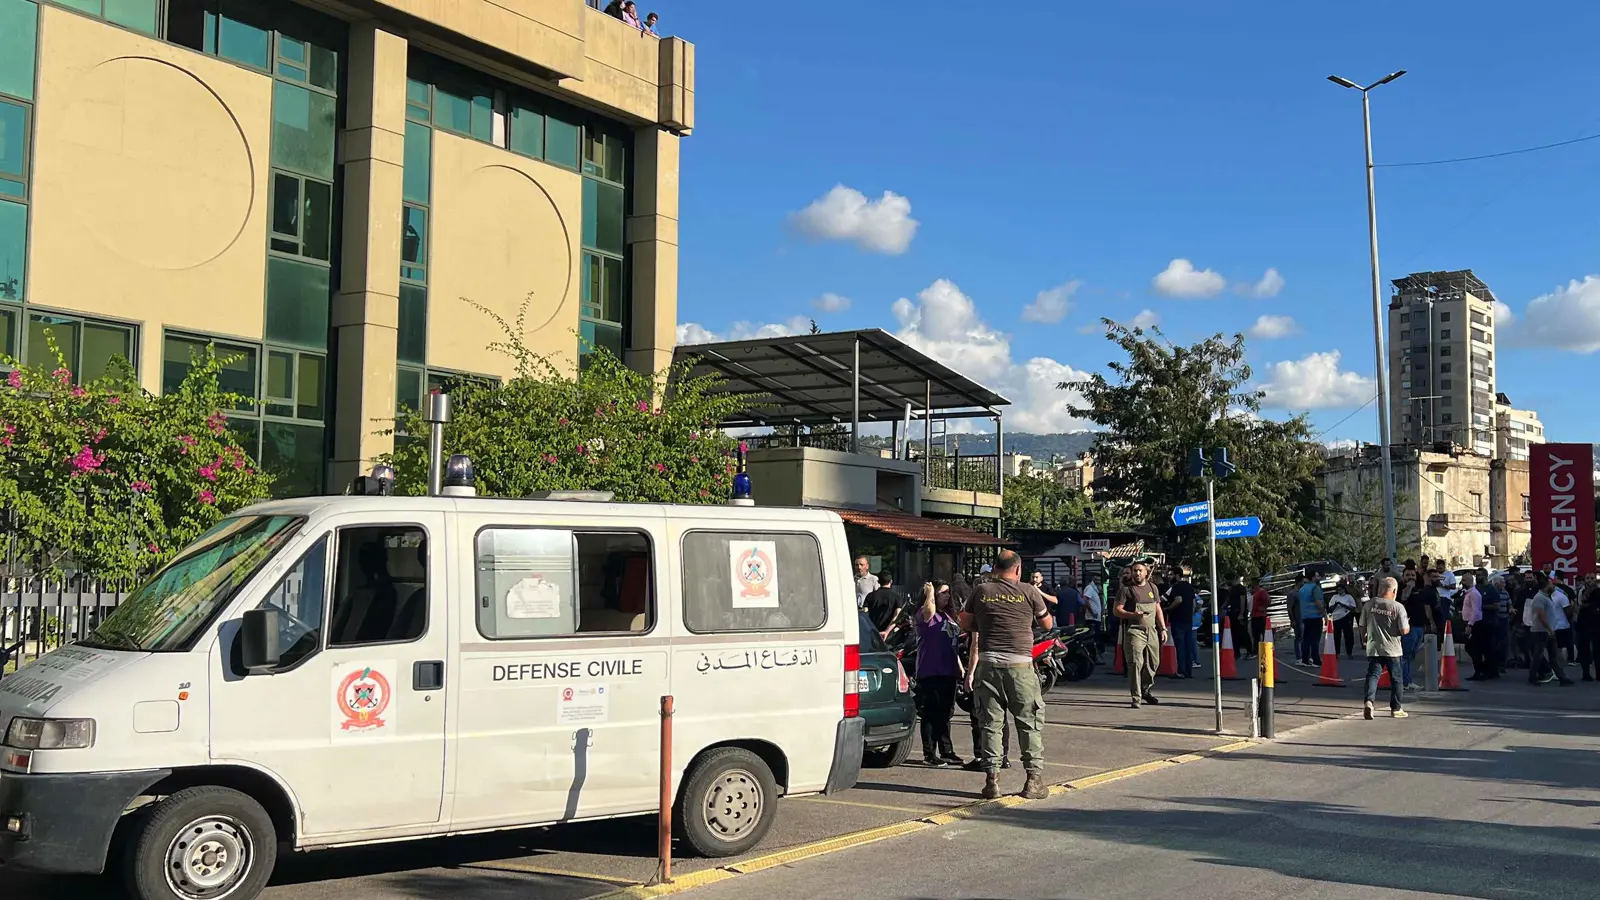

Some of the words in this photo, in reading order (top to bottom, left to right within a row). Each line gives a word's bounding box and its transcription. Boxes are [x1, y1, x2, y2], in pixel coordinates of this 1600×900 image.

[1188, 503, 1208, 512] ENTRANCE
[1215, 519, 1249, 527] WAREHOUSES
[1082, 540, 1108, 548] PARKING
[493, 662, 581, 681] DEFENSE
[587, 659, 643, 677] CIVILE
